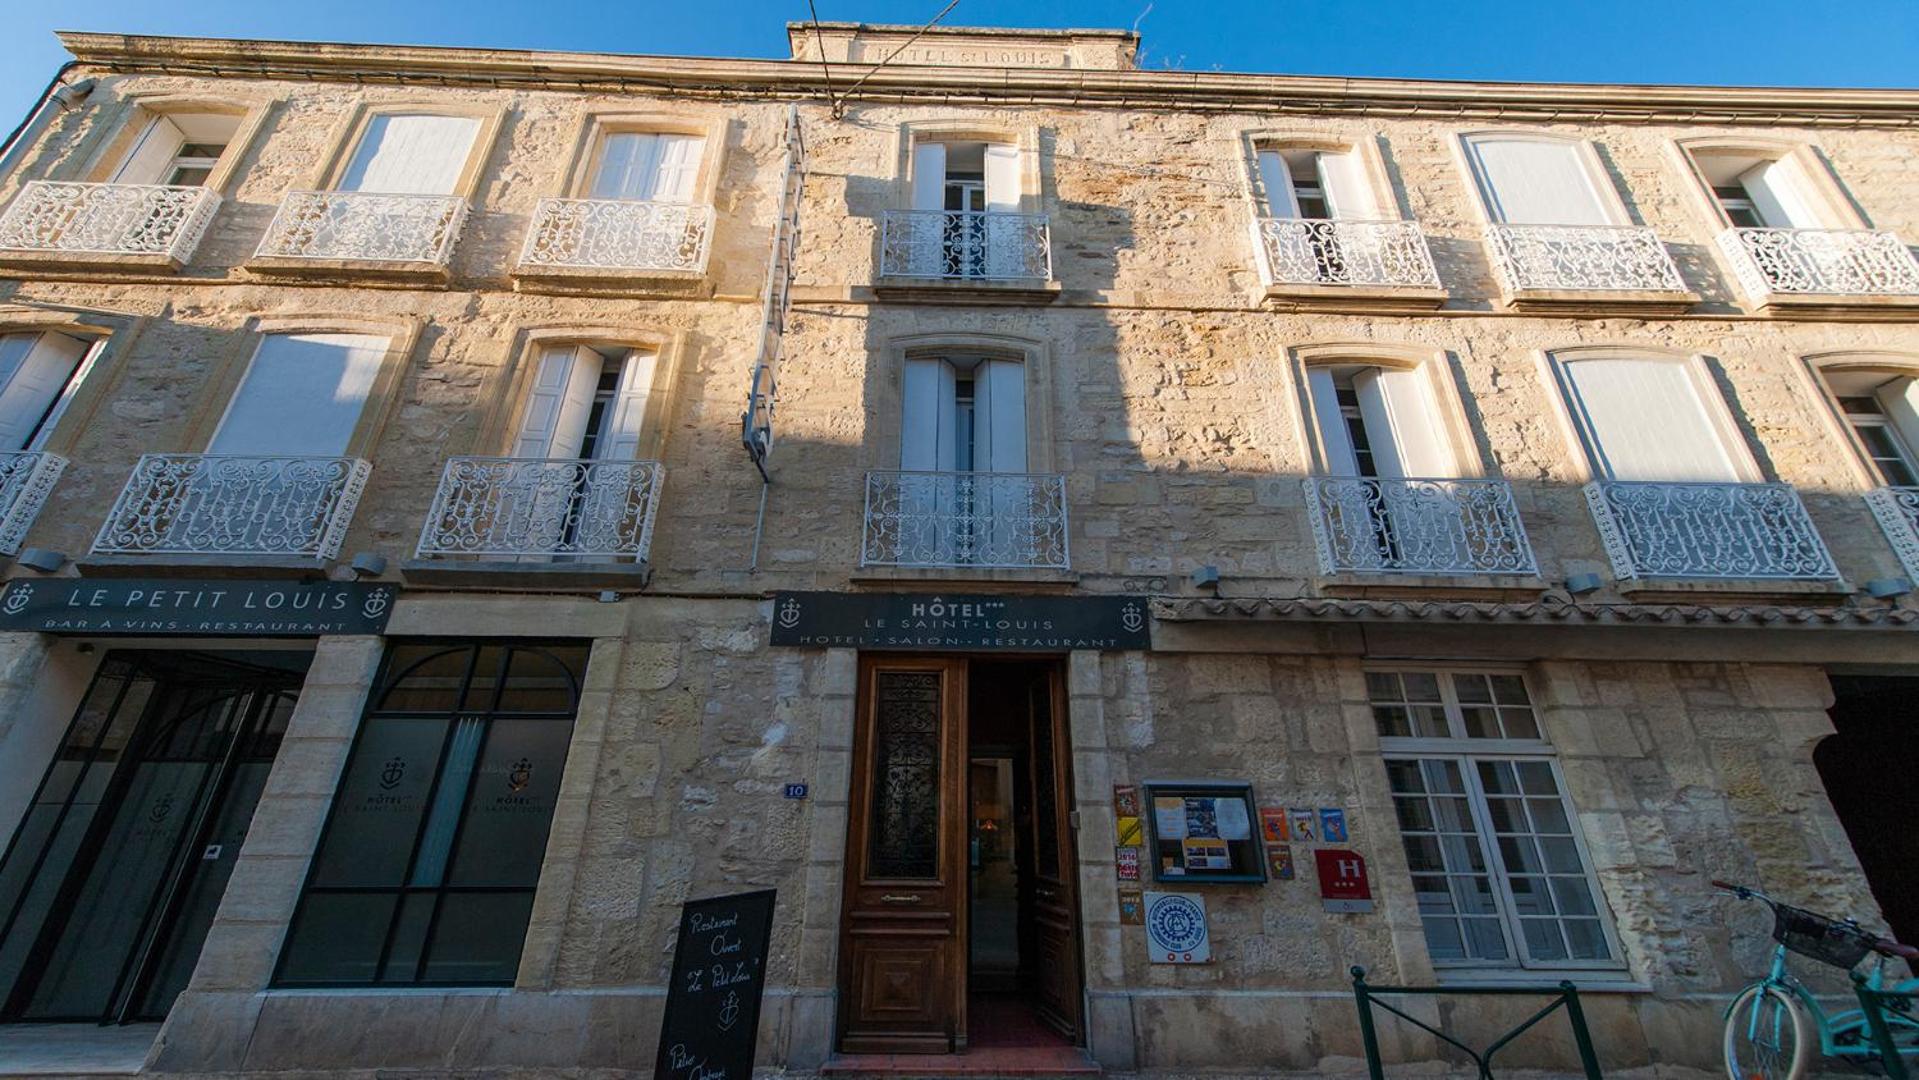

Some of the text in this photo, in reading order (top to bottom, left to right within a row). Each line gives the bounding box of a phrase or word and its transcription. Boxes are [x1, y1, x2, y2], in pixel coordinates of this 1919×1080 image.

[67, 588, 349, 610] LE PETIT LOUIS
[912, 596, 986, 617] HÔTEL
[44, 619, 88, 628] BAR
[125, 619, 177, 629] VINS
[199, 621, 346, 631] RESTAURANT
[864, 618, 886, 628] LE
[800, 635, 1118, 647] HOTEL SALON RESTAURANT
[785, 783, 803, 795] 10
[1337, 859, 1360, 878] H
